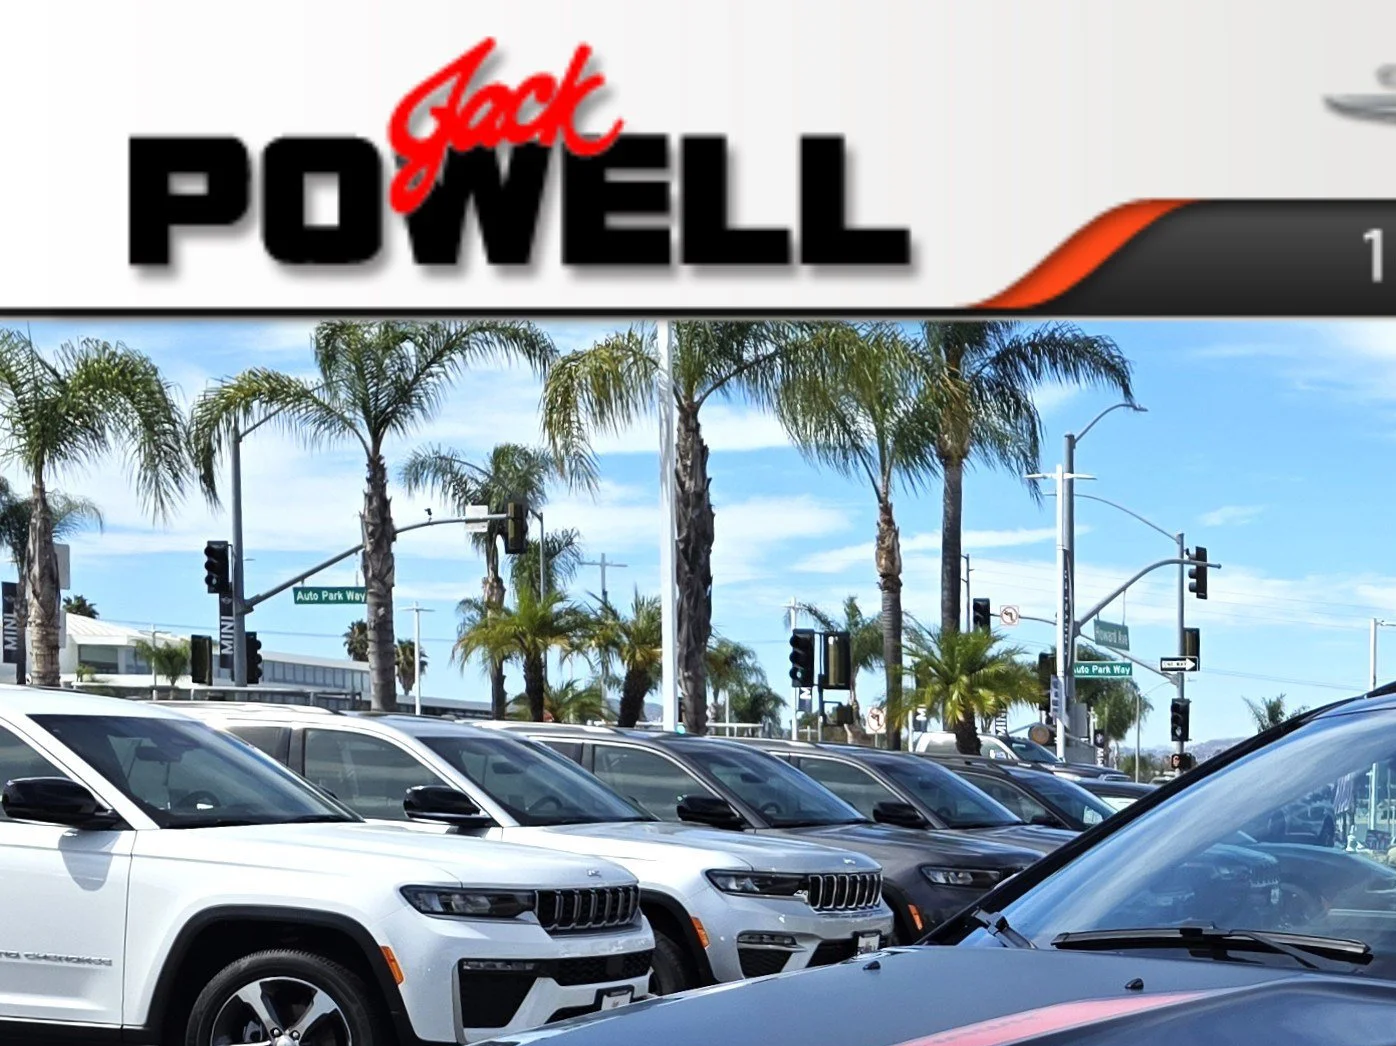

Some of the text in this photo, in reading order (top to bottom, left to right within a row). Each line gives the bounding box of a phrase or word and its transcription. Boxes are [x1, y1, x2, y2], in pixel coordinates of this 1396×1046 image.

[296, 590, 366, 603] Auto Park Way
[4, 612, 18, 651] MINI
[220, 615, 235, 655] MINI
[1091, 664, 1112, 674] Park
[1113, 664, 1131, 675] Way
